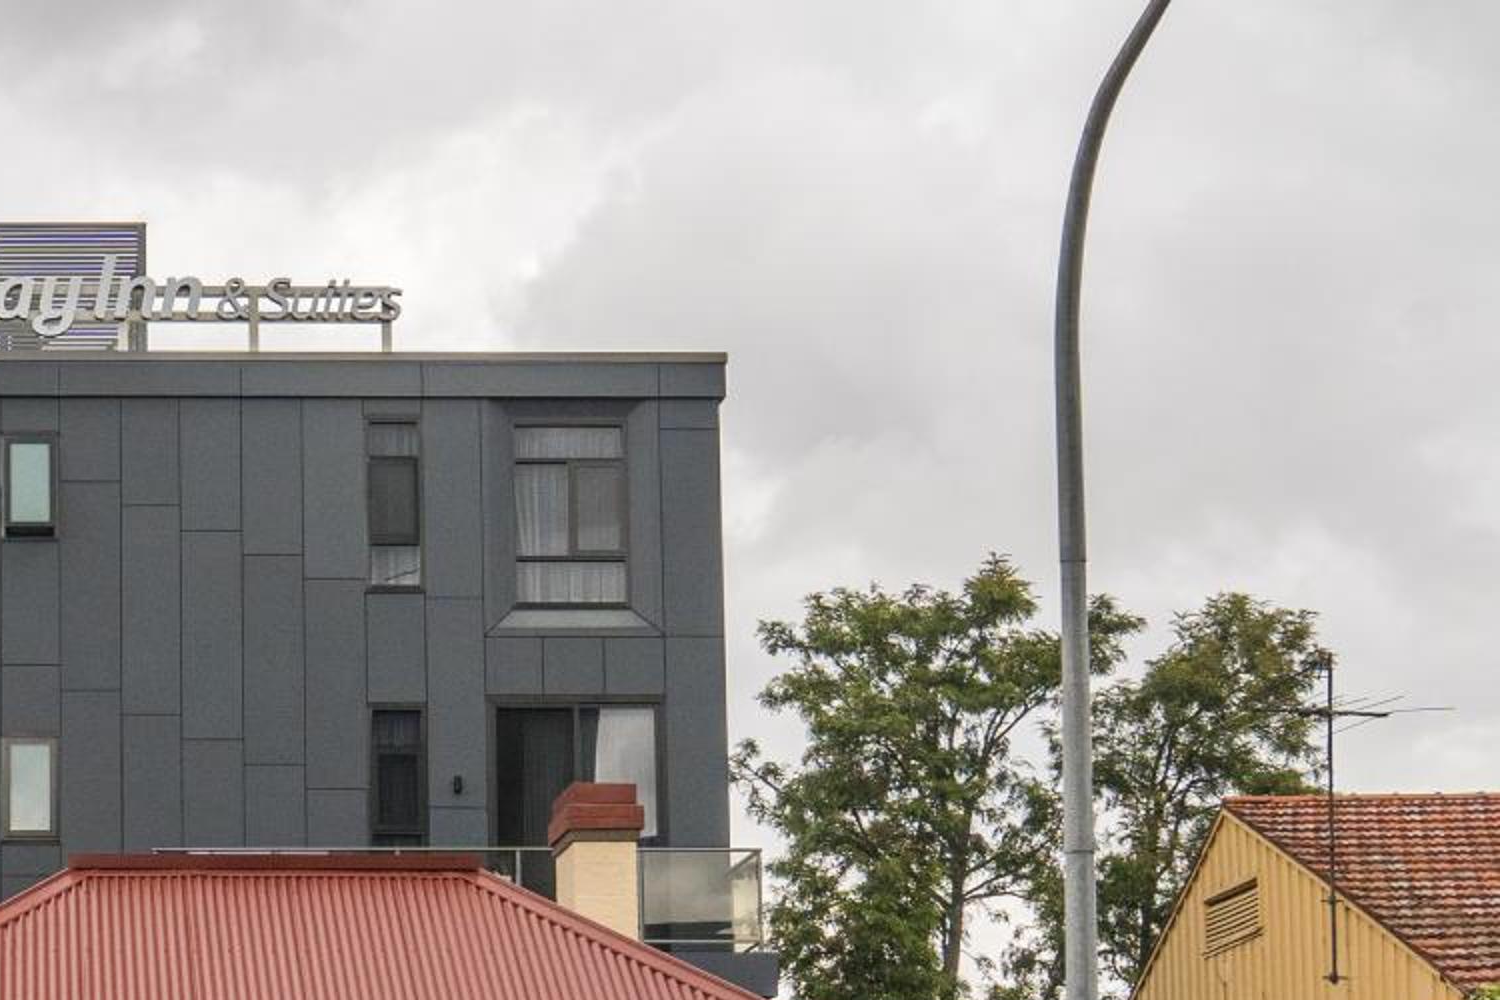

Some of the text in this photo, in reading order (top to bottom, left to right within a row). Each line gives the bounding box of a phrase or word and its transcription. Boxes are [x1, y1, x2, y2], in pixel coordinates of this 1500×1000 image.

[93, 254, 204, 321] Inn
[216, 277, 250, 320] &
[257, 277, 404, 321] Suites
